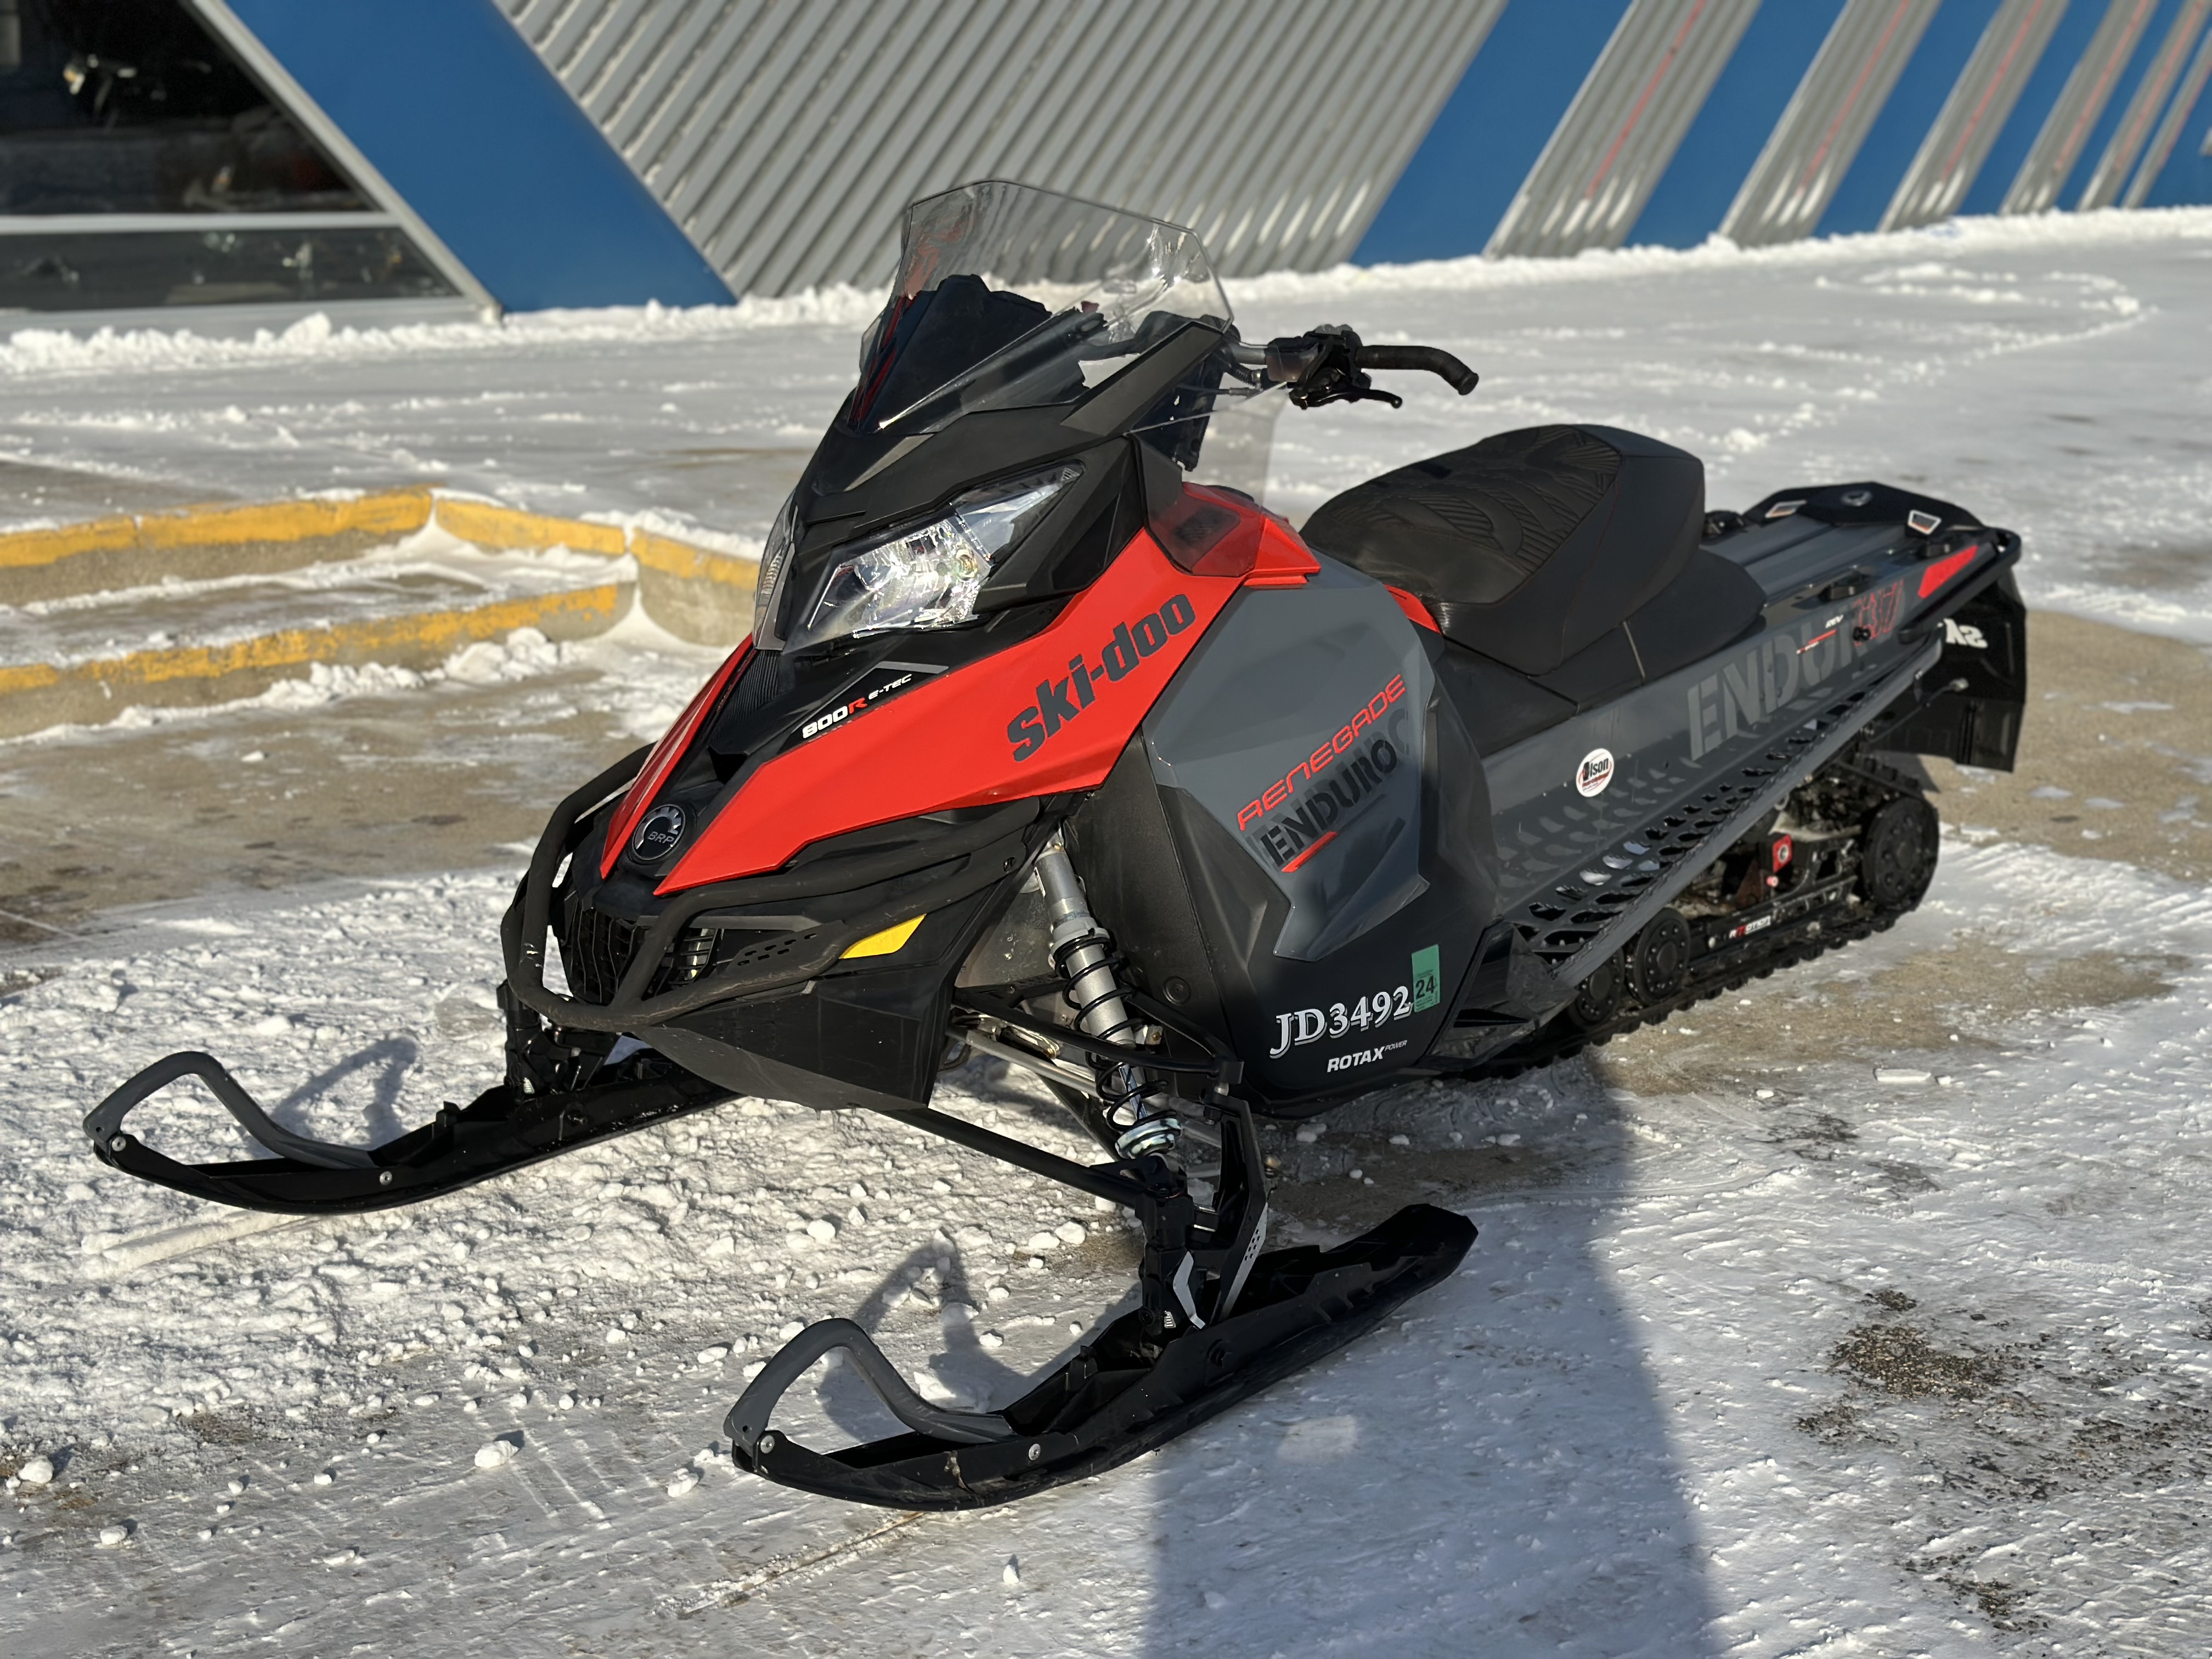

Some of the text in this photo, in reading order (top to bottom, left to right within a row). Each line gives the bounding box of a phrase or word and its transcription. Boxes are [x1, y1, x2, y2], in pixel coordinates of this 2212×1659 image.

[802, 674, 912, 738] 800R E-TEC
[1238, 674, 1406, 831] RENEGADE
[1260, 739, 1397, 867] ENDURO
[648, 831, 675, 844] BRP
[1415, 975, 1435, 1000] 24
[1269, 985, 1413, 1059] JD3492
[1327, 1040, 1408, 1073] ROTAX POWER
